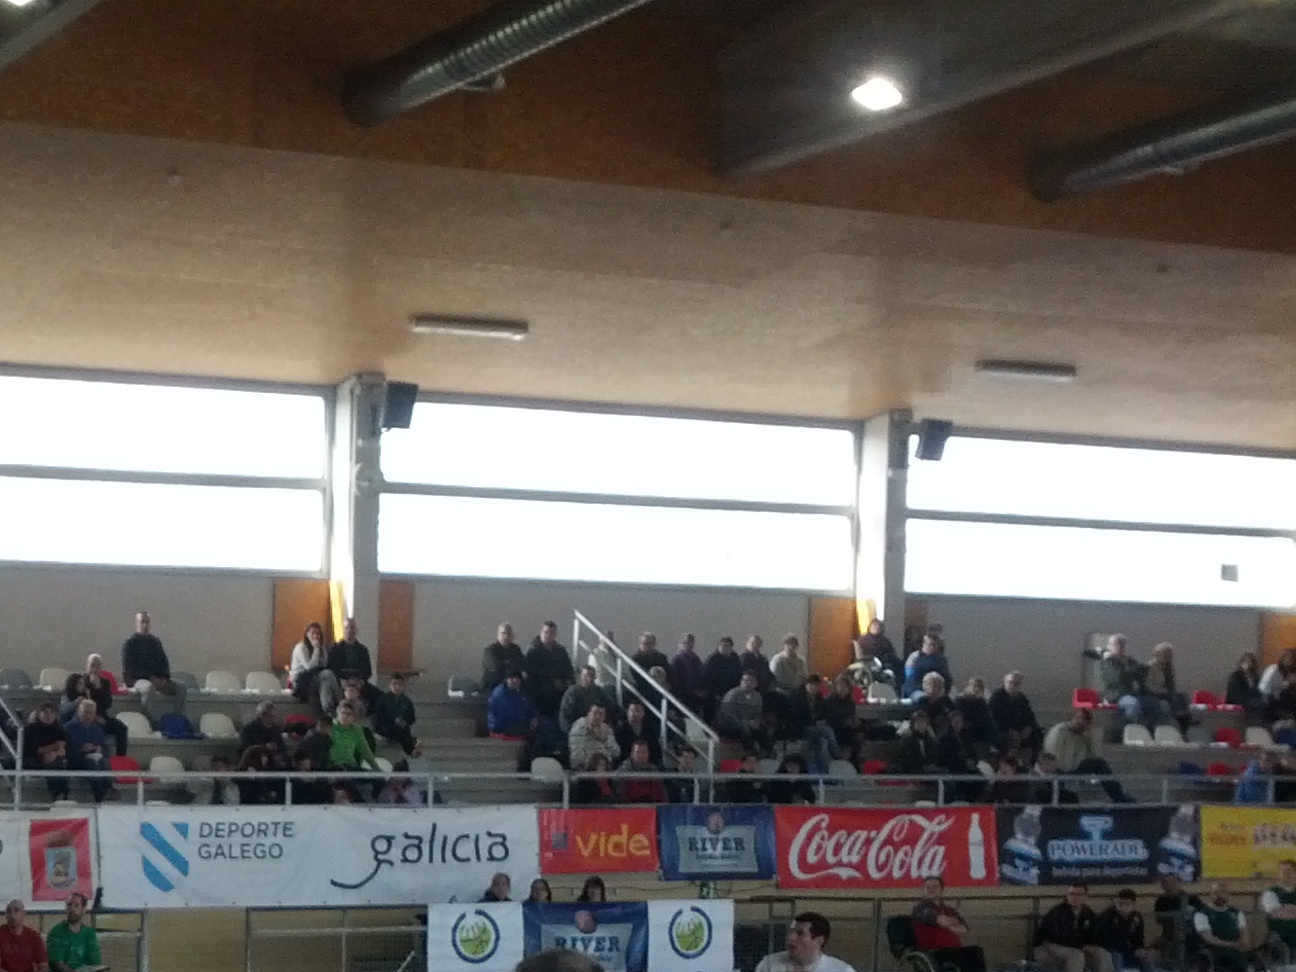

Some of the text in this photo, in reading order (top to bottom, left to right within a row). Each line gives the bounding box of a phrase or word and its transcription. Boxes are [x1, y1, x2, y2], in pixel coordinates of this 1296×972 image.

[199, 821, 294, 839] DEPORTE
[575, 822, 651, 858] vide
[688, 837, 745, 852] RIVER
[788, 813, 954, 880] Coca-Cola
[198, 843, 284, 860] GALEGO
[330, 822, 510, 889] galicia
[1049, 841, 1145, 859] POWERADE
[554, 935, 621, 952] RIVER
